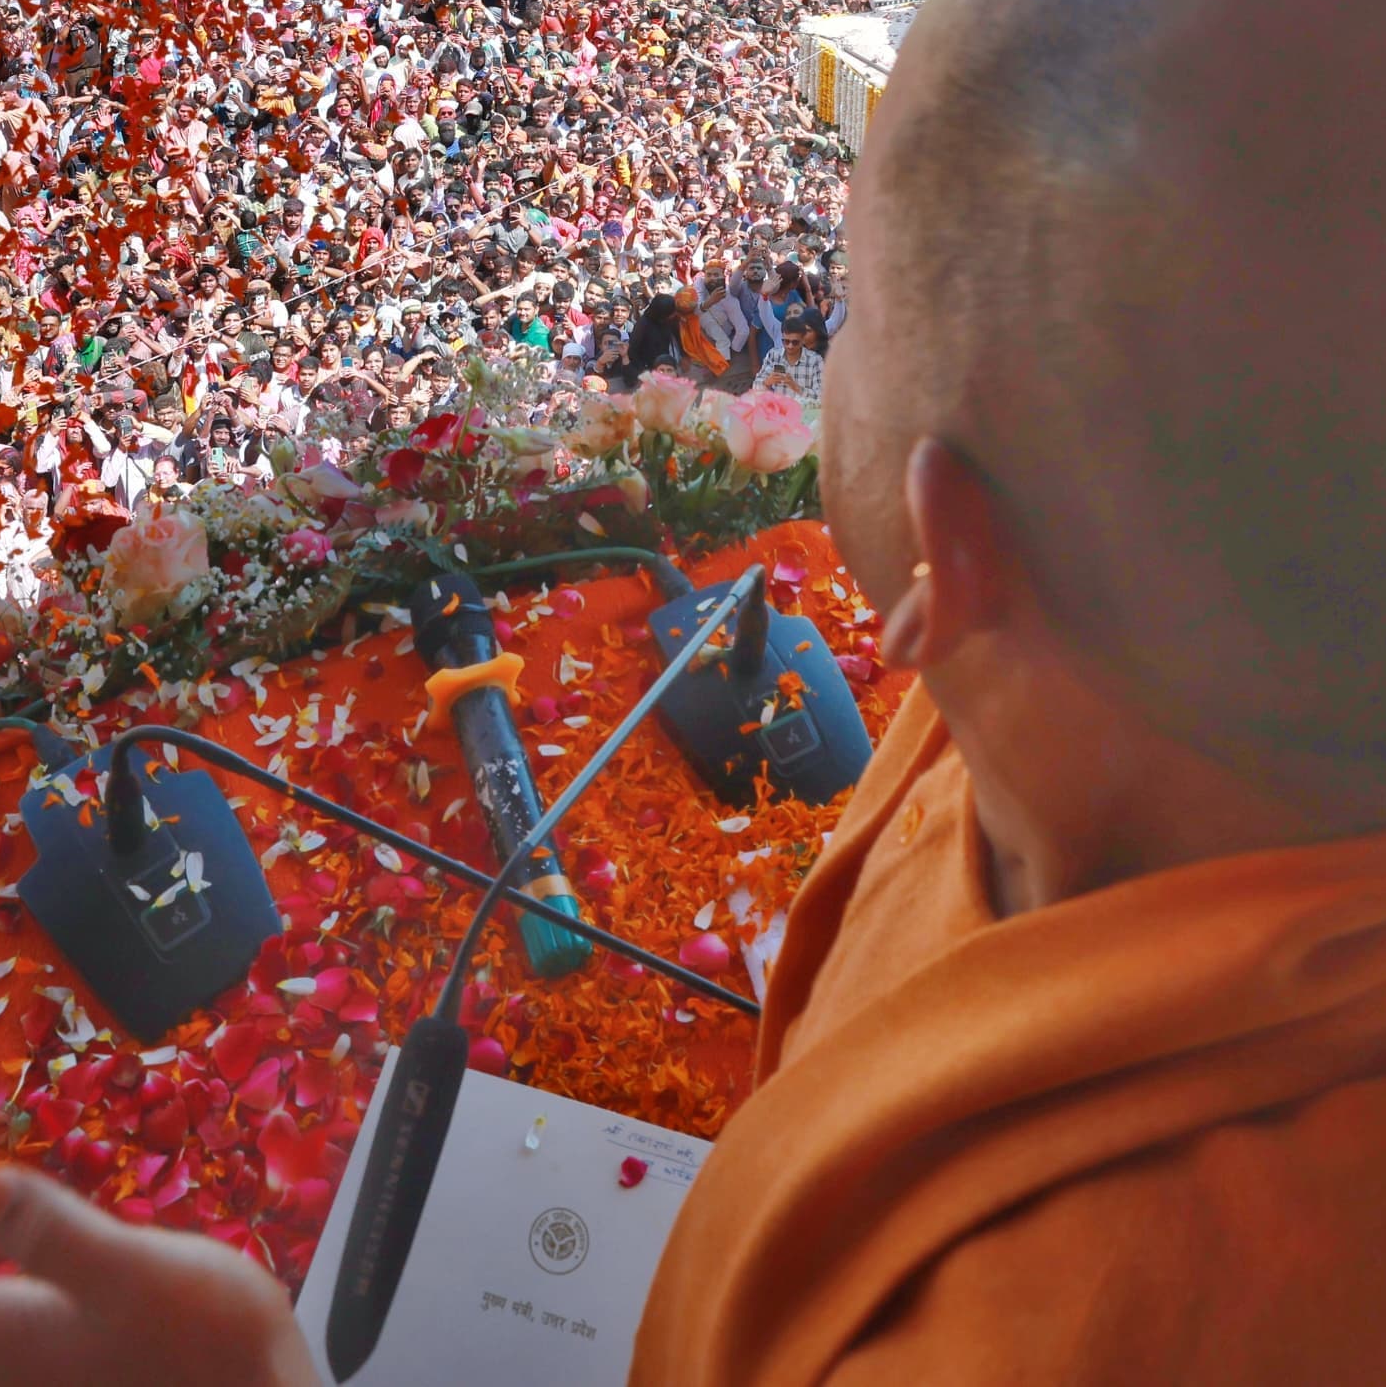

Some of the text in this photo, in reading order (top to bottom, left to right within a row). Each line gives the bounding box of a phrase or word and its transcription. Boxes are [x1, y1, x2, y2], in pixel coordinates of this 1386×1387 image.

[480, 1292, 508, 1311] मुख्य
[541, 1311, 568, 1333] उत्तर
[571, 1318, 597, 1342] प्रदेश
